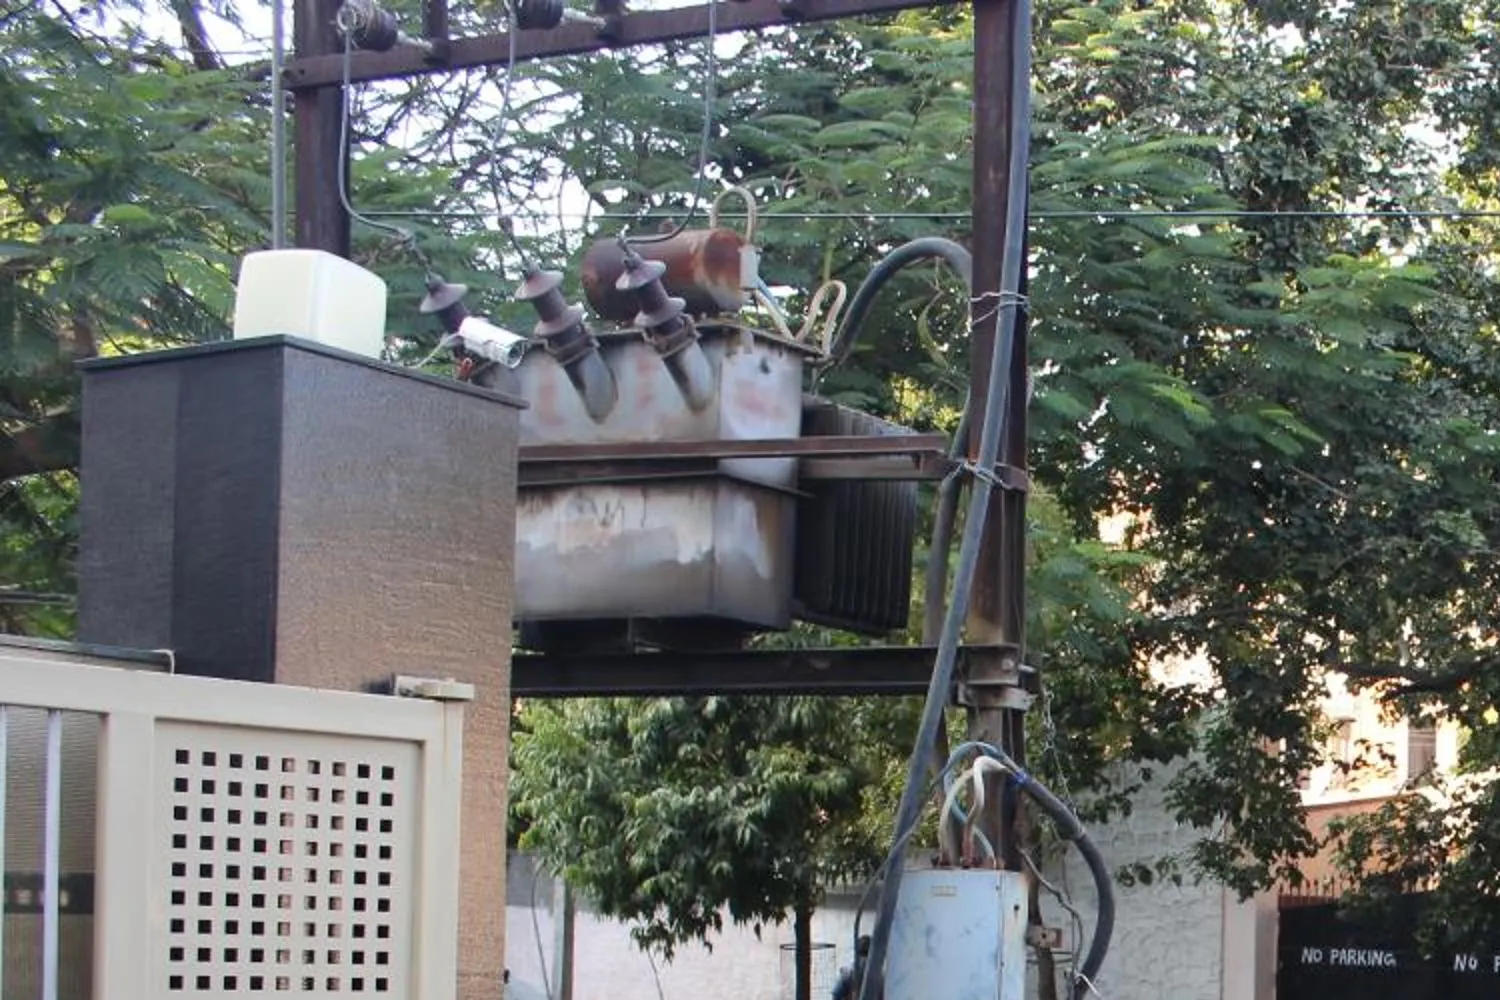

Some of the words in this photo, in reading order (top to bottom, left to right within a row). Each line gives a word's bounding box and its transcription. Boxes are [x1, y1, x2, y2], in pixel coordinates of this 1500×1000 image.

[1301, 946, 1324, 964] NO
[1329, 948, 1397, 967] PARKING
[1453, 952, 1479, 972] NO
